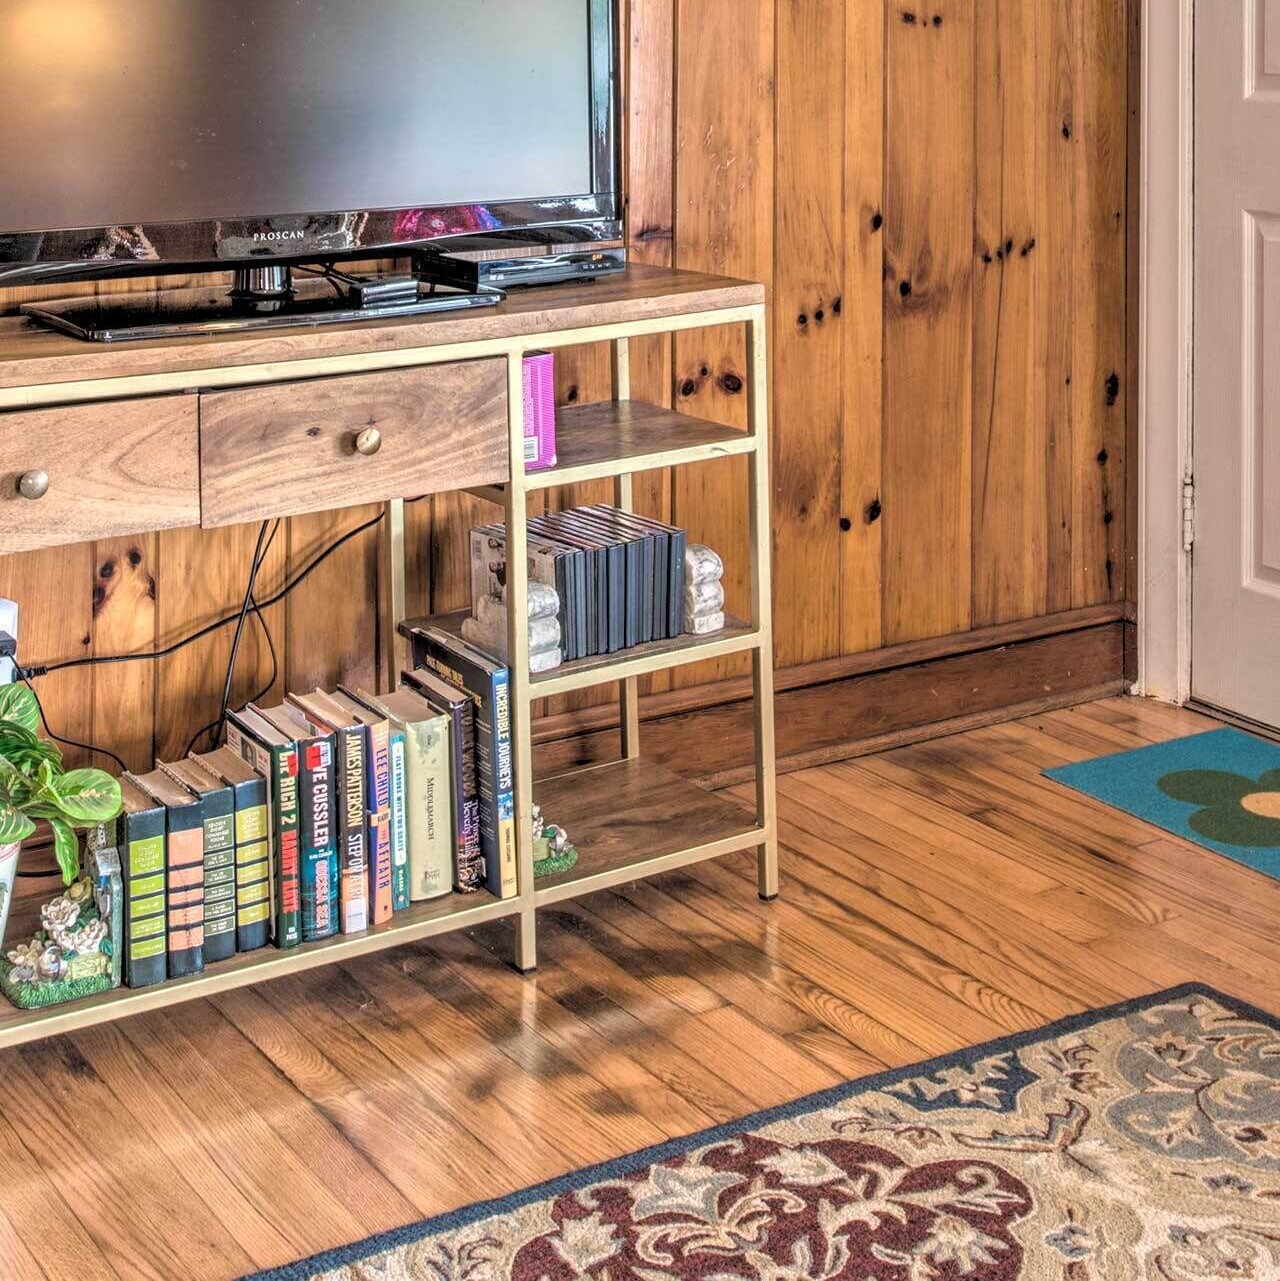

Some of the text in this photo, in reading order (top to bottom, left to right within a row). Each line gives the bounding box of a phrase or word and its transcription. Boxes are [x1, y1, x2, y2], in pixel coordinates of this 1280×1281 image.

[253, 230, 305, 242] PROSCAN
[495, 683, 512, 789] INCREDIBLE JOURNEYS
[376, 748, 388, 770] LEE
[280, 776, 296, 811] RICH
[346, 734, 363, 827] JAMES PATTERSON
[377, 771, 388, 807] CHILD
[281, 814, 296, 825] 2
[312, 783, 330, 847] CUSSLER
[463, 801, 474, 834] Beverly
[348, 833, 363, 856] STEP
[378, 842, 390, 889] AFFAIR
